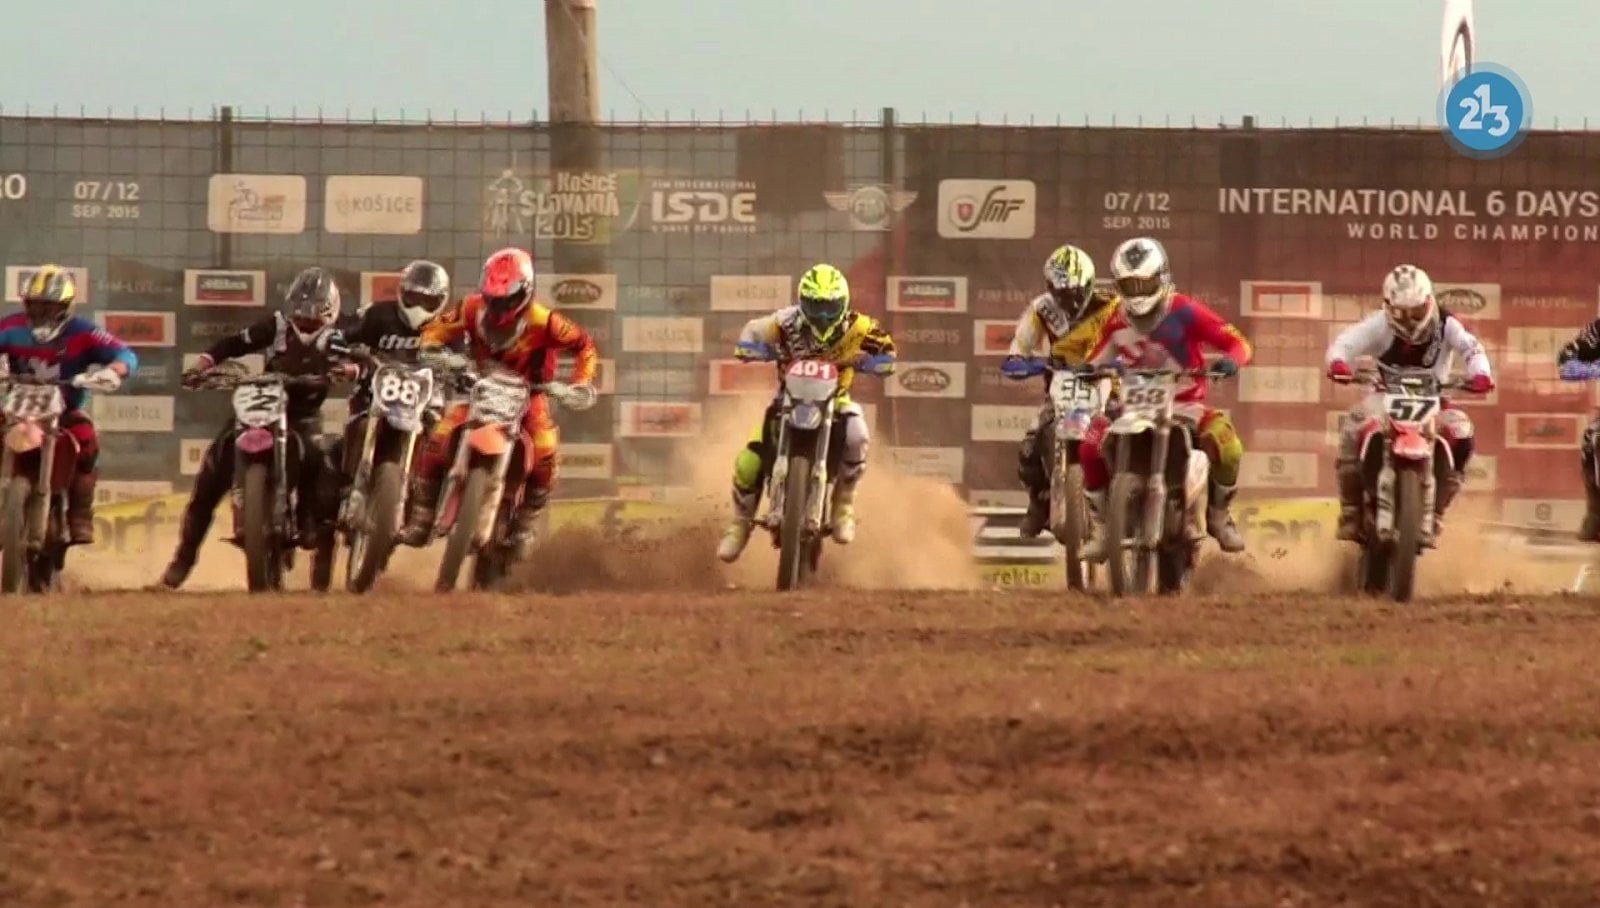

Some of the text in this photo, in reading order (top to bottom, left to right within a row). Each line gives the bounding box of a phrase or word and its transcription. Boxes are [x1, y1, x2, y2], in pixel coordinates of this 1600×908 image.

[0, 173, 27, 200] O
[106, 204, 140, 218] 2015
[652, 191, 757, 223] ISDE
[1218, 188, 1600, 218] INTERNATIONAL 6 DAYS
[1137, 216, 1170, 230] 2015
[1347, 223, 1600, 242] WORLD CHAMPION
[789, 359, 831, 380] 401
[380, 374, 421, 405] 88
[1389, 399, 1436, 421] 57
